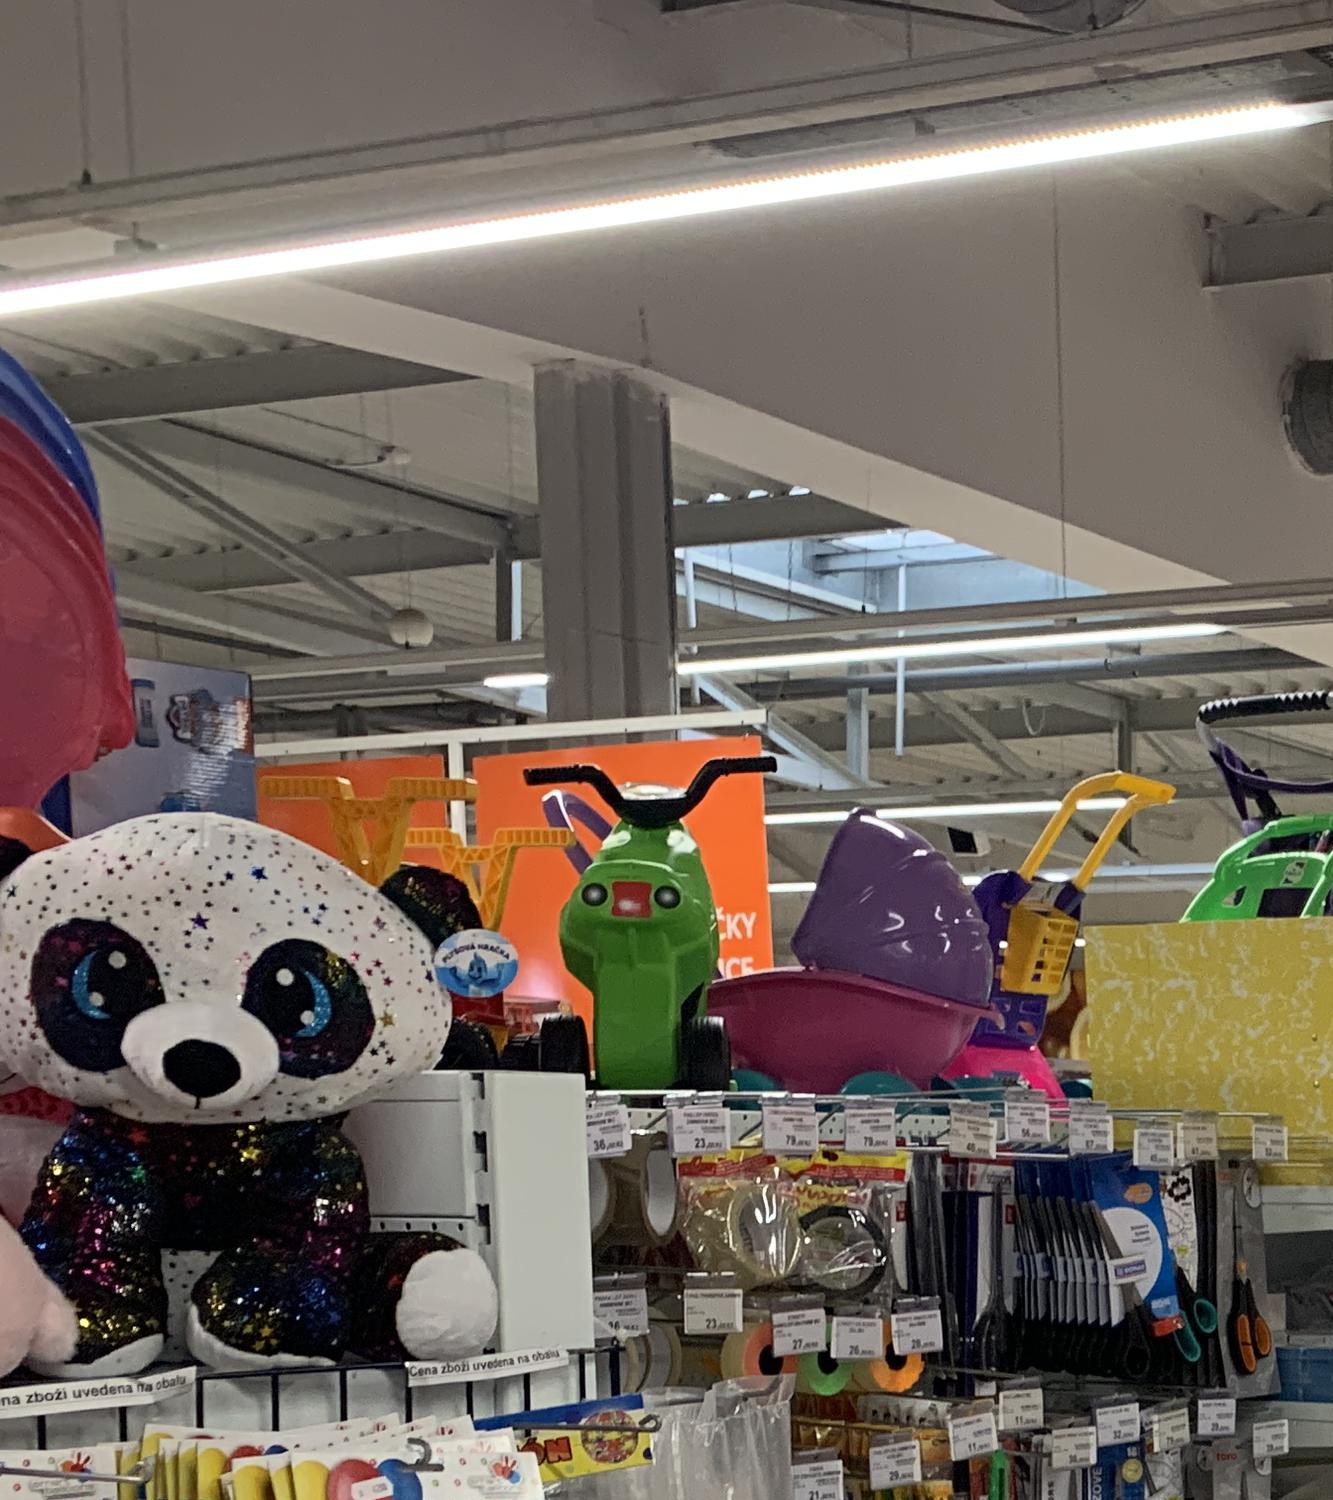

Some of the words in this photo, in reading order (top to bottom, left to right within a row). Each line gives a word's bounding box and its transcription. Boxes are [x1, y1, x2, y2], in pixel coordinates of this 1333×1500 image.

[409, 1365, 437, 1378] Cena
[440, 1360, 468, 1376] zboží
[472, 1358, 514, 1373] uvedena
[516, 1355, 529, 1365] na
[532, 1349, 560, 1364] obalu
[26, 1386, 68, 1404] zboží
[73, 1382, 133, 1400] uvedena
[155, 1374, 187, 1391] obalu
